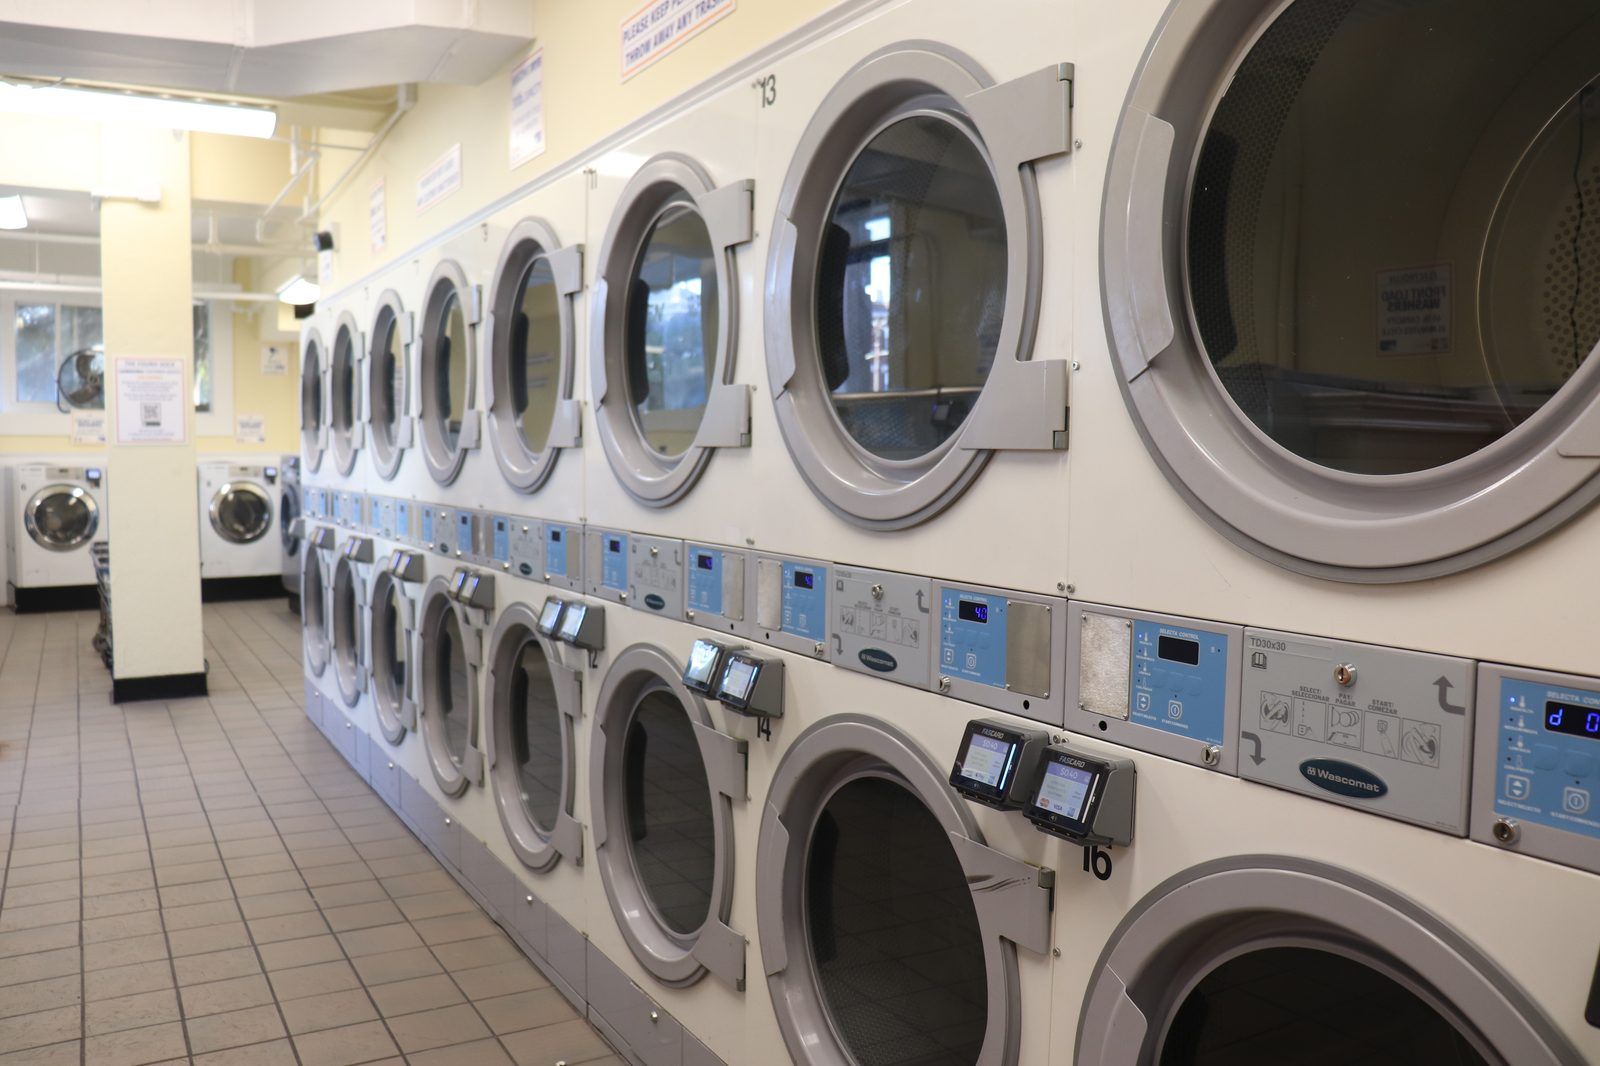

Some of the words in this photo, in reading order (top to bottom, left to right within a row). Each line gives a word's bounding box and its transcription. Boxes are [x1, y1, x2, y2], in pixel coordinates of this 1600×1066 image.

[623, 14, 649, 41] PLEASE
[651, 0, 669, 23] KEEP
[625, 37, 651, 65] THROW
[653, 25, 674, 47] AWAY
[677, 12, 692, 33] ANY
[695, 0, 724, 19] TRAS
[760, 74, 776, 108] 13
[974, 606, 988, 620] 40
[1250, 637, 1287, 651] TD30x30
[982, 728, 1005, 739] FASCARD
[1058, 755, 1085, 768] FASCARD
[1316, 768, 1380, 792] Wascomat
[1083, 844, 1112, 880] 16
